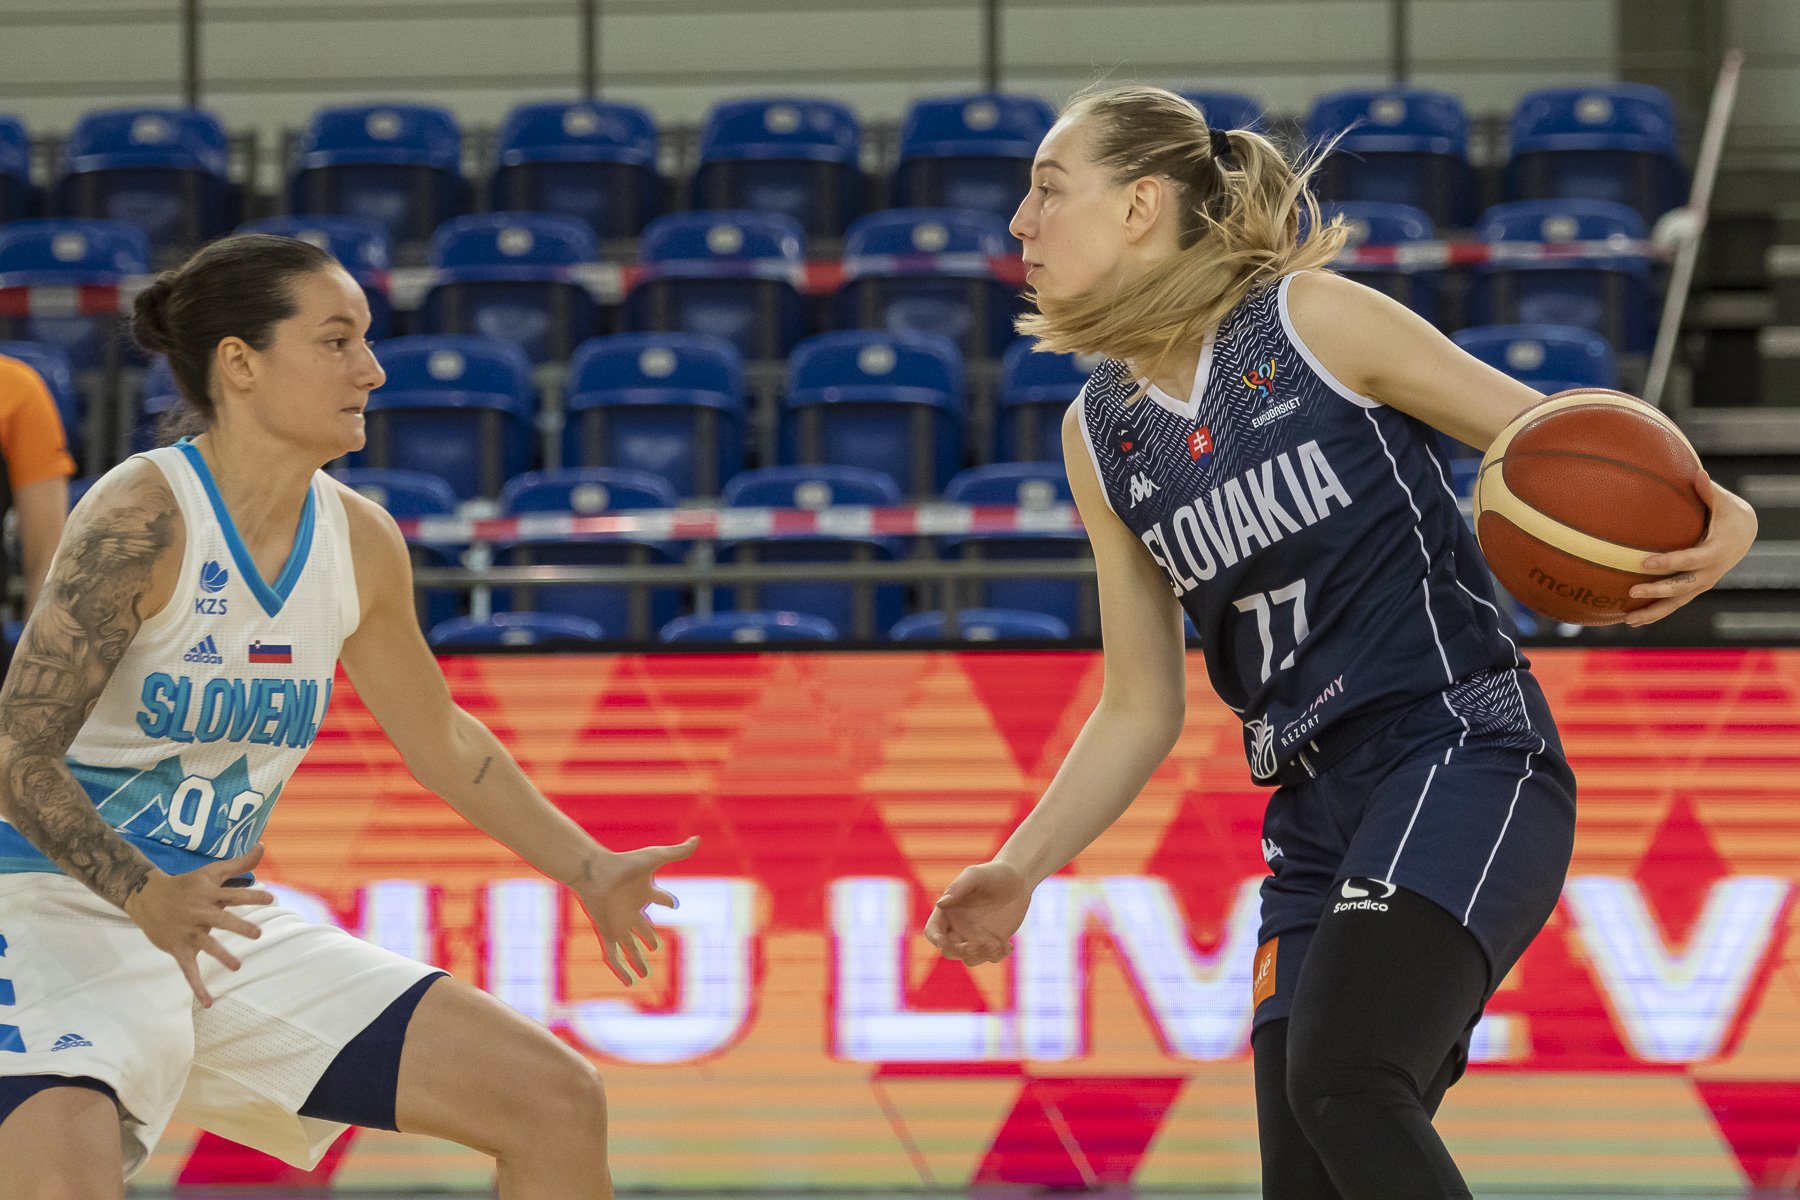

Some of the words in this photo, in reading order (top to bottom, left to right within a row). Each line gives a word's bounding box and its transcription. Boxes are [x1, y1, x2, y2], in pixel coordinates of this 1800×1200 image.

[1252, 397, 1301, 429] EUROBASKET
[1141, 440, 1353, 597] SLOVAKIA
[1528, 566, 1627, 609] molten
[195, 598, 228, 615] KZS
[1232, 578, 1310, 684] 77
[183, 652, 224, 664] adidas
[1281, 714, 1320, 748] REZORT
